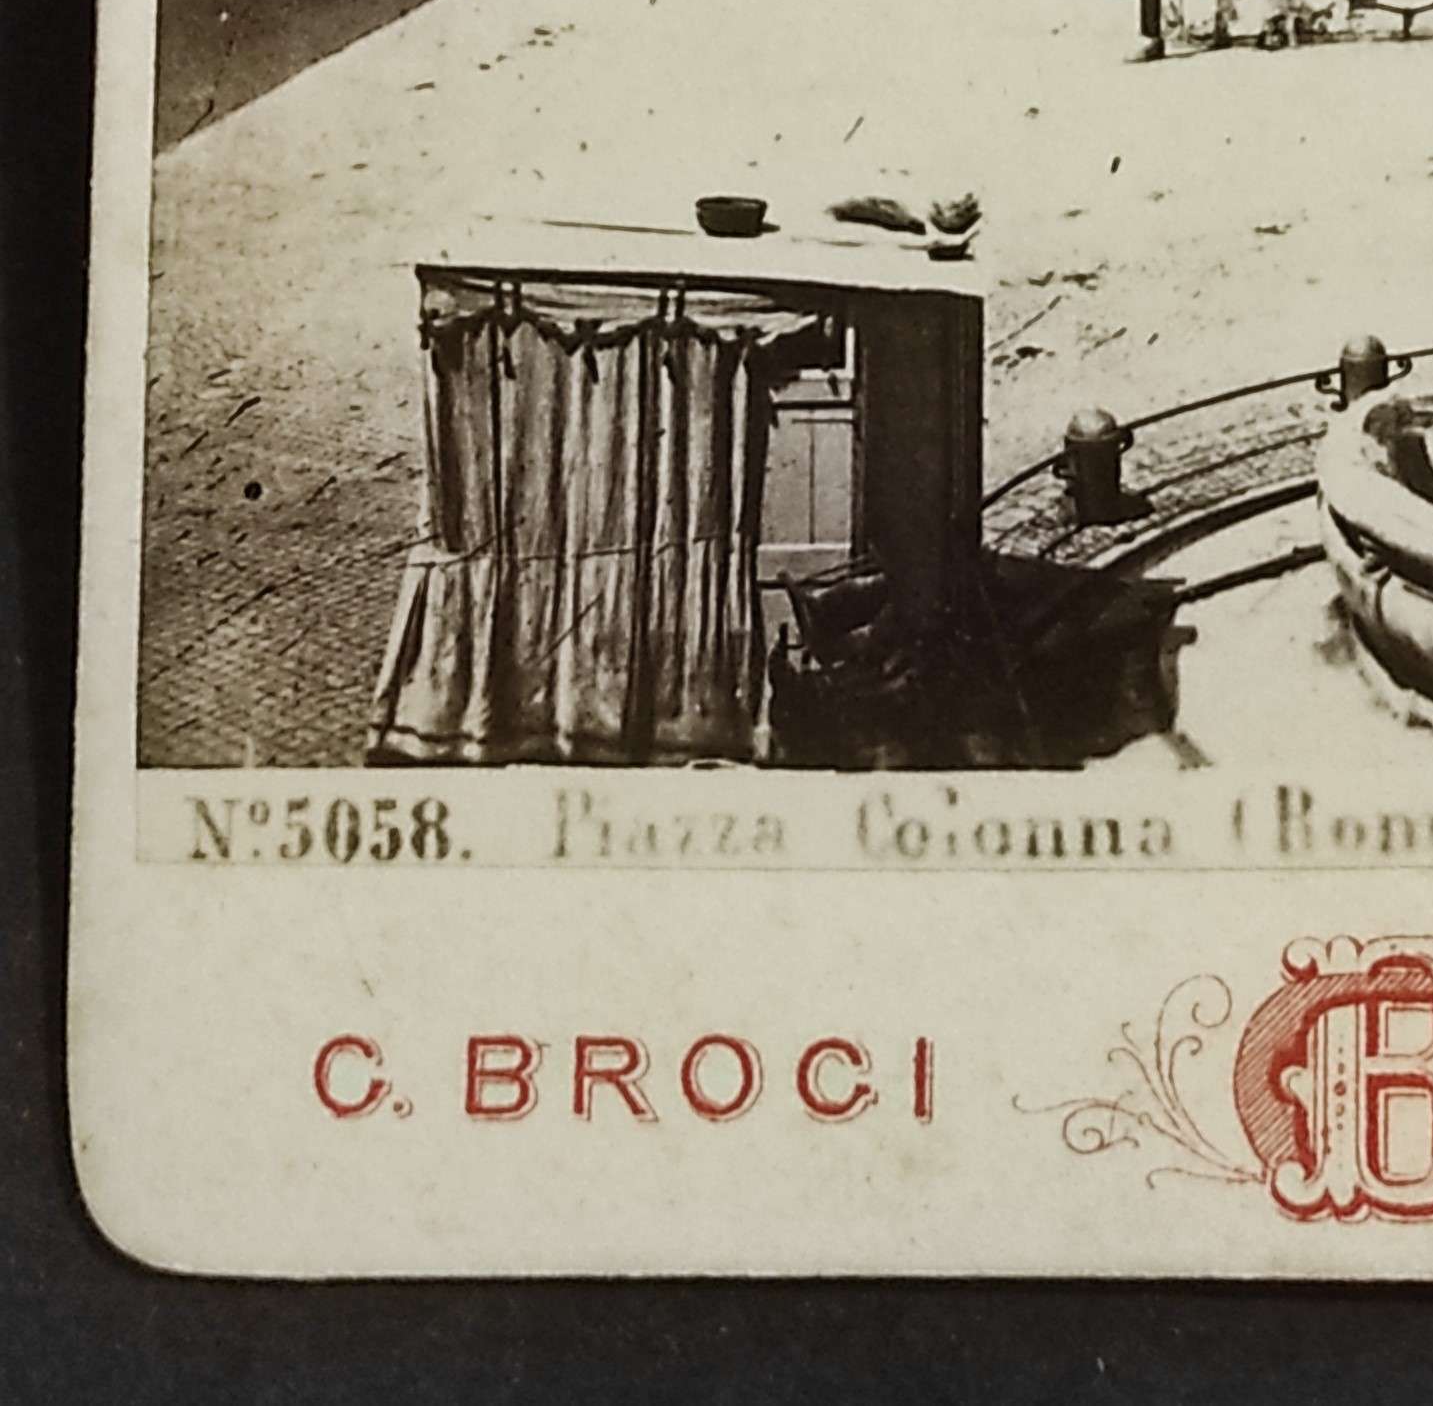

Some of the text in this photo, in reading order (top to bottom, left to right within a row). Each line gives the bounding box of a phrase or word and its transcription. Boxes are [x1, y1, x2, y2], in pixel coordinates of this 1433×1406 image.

[552, 787, 784, 860] Piazza
[856, 786, 1173, 860] Colonna
[313, 1036, 938, 1123] C. BROCI
